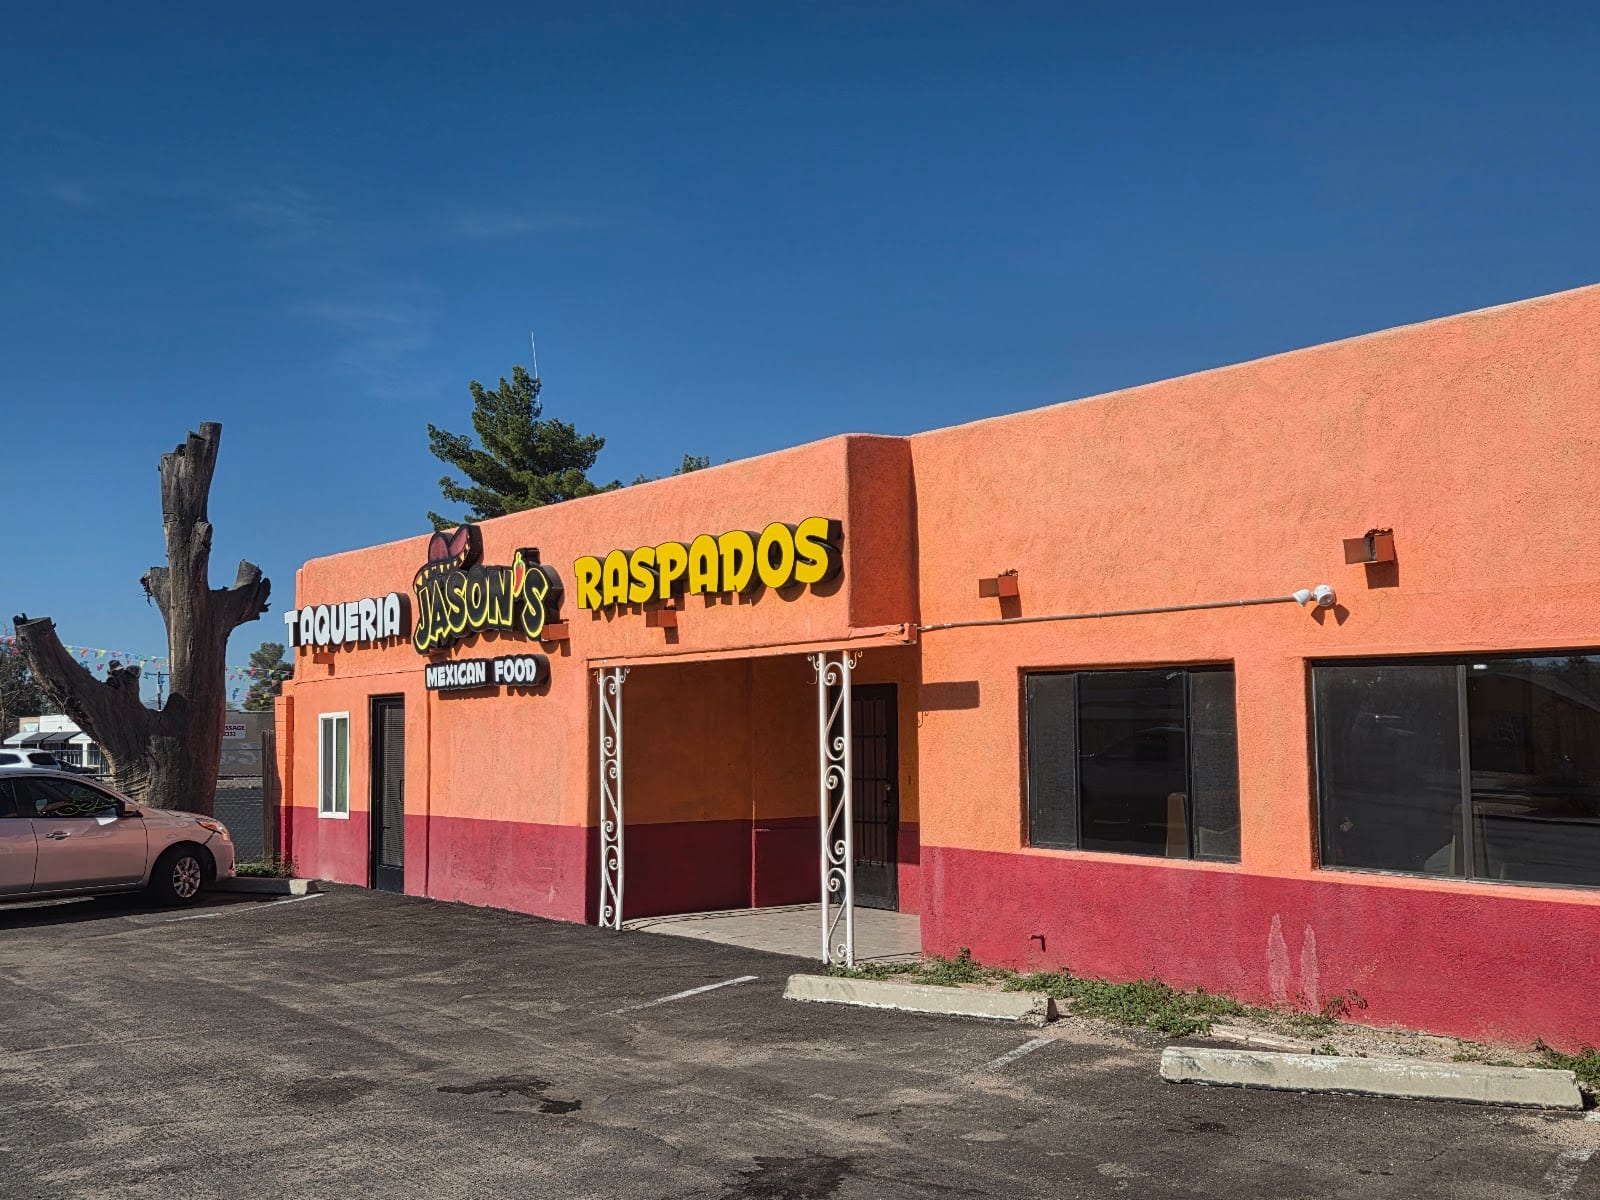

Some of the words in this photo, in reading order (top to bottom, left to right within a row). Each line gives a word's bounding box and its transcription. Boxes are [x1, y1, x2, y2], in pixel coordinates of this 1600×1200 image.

[415, 551, 549, 651] JASON'S
[574, 516, 829, 611] RASPADOS
[284, 592, 400, 647] TAQUERIA
[426, 661, 486, 688] MEXICAN
[494, 657, 537, 683] FOOD
